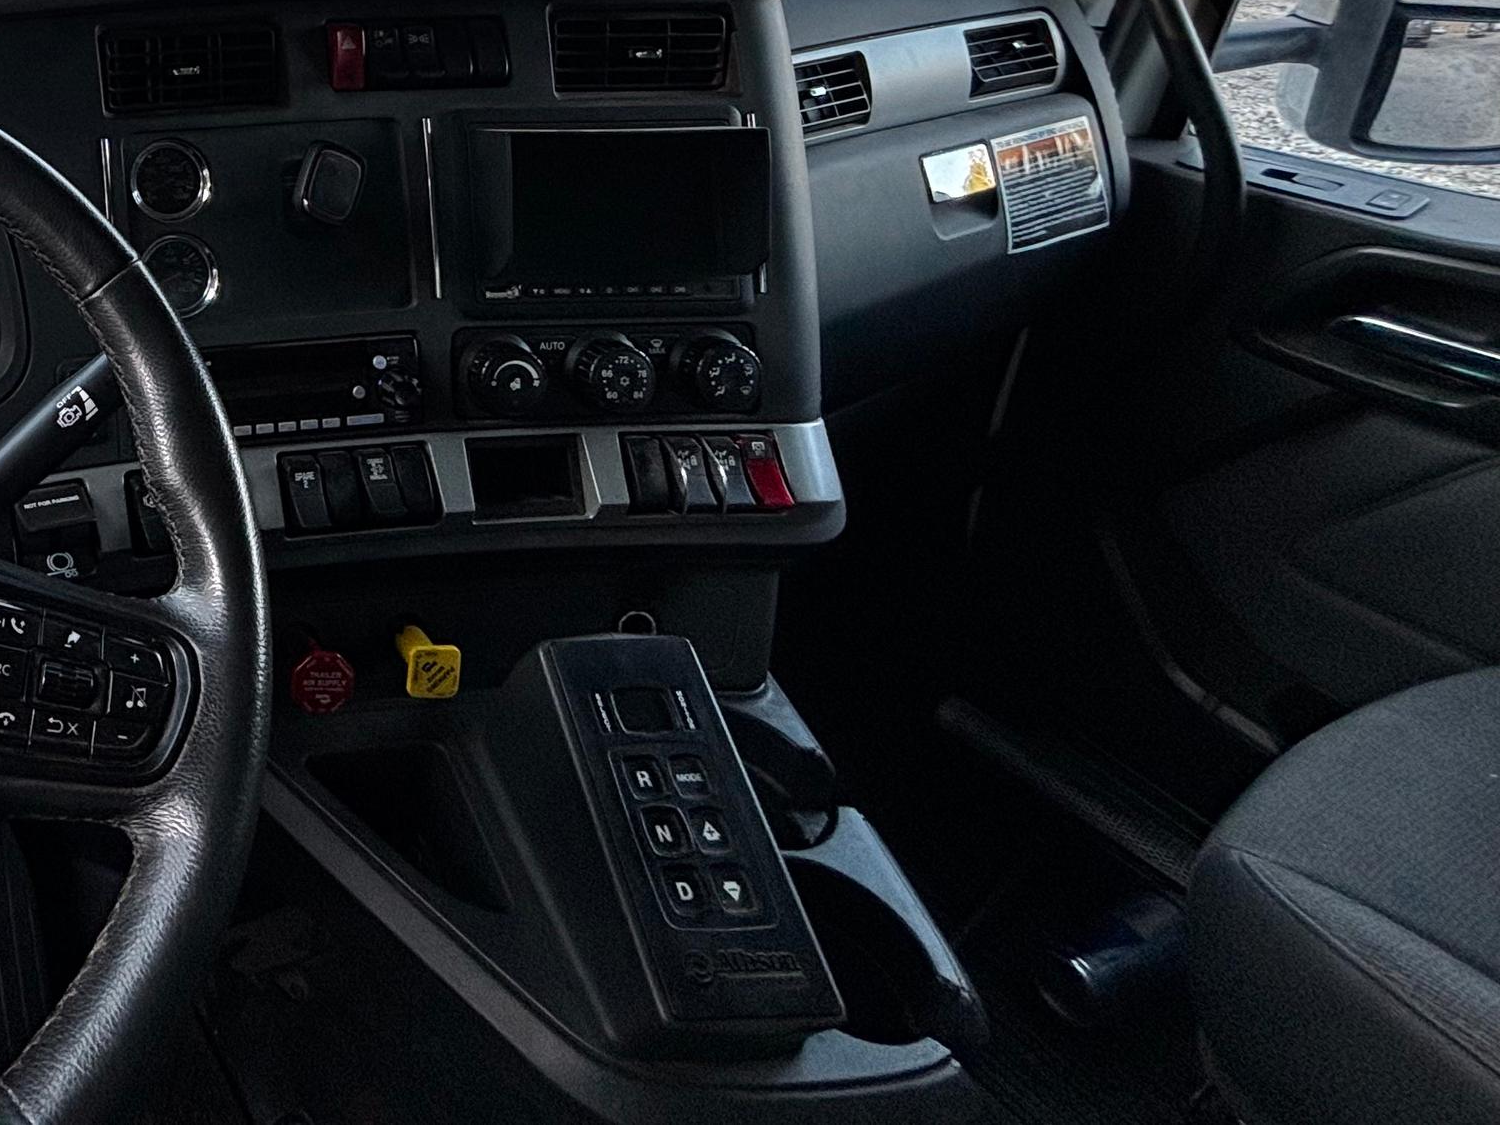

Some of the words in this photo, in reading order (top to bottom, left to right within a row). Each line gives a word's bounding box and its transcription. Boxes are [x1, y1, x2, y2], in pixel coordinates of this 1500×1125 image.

[539, 341, 566, 352] AUTO
[618, 355, 629, 364] 72
[23, 502, 37, 510] NOT
[37, 499, 51, 507] FOR
[309, 671, 342, 679] TRAILER
[317, 679, 348, 687] SUPPLY
[636, 770, 655, 788] R
[675, 772, 705, 783] MODE
[656, 823, 674, 844] N
[676, 881, 694, 901] D
